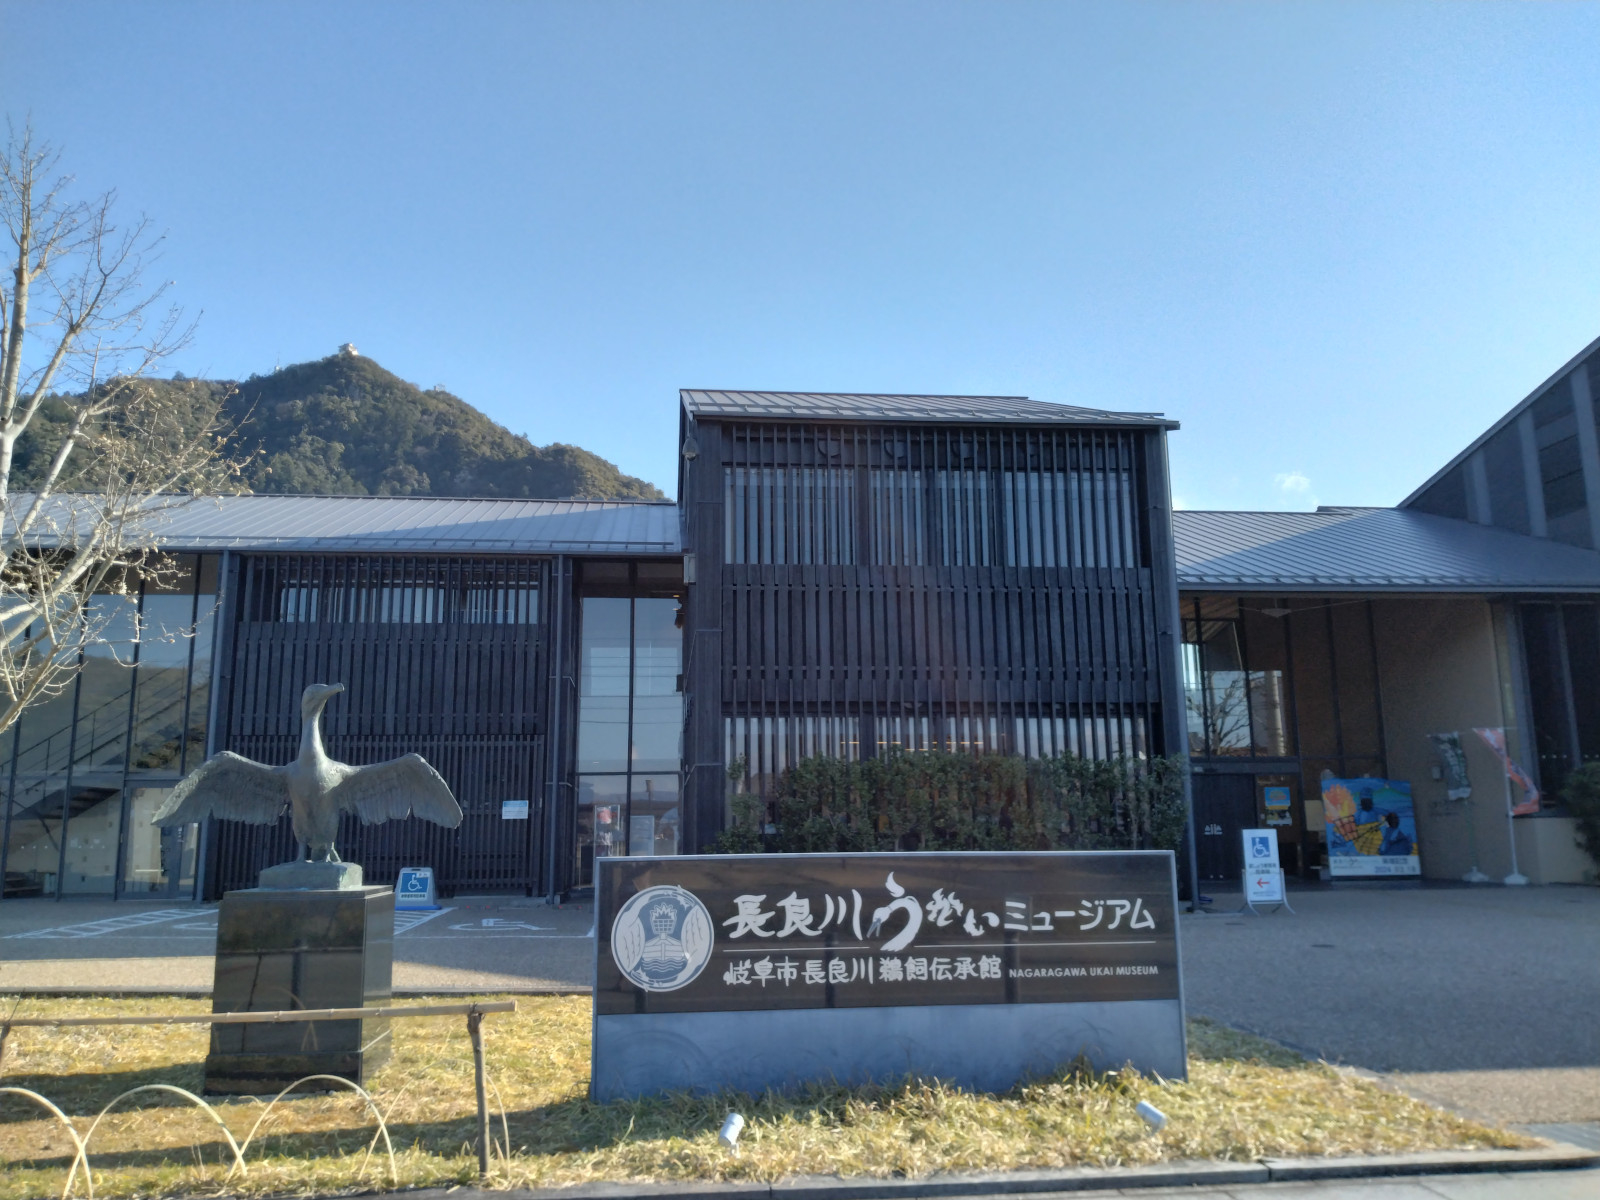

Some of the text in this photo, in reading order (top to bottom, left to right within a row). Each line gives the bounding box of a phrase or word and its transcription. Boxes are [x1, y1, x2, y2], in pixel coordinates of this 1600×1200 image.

[1009, 965, 1159, 978] NAGARAGAWA UKAI MUSEUM
